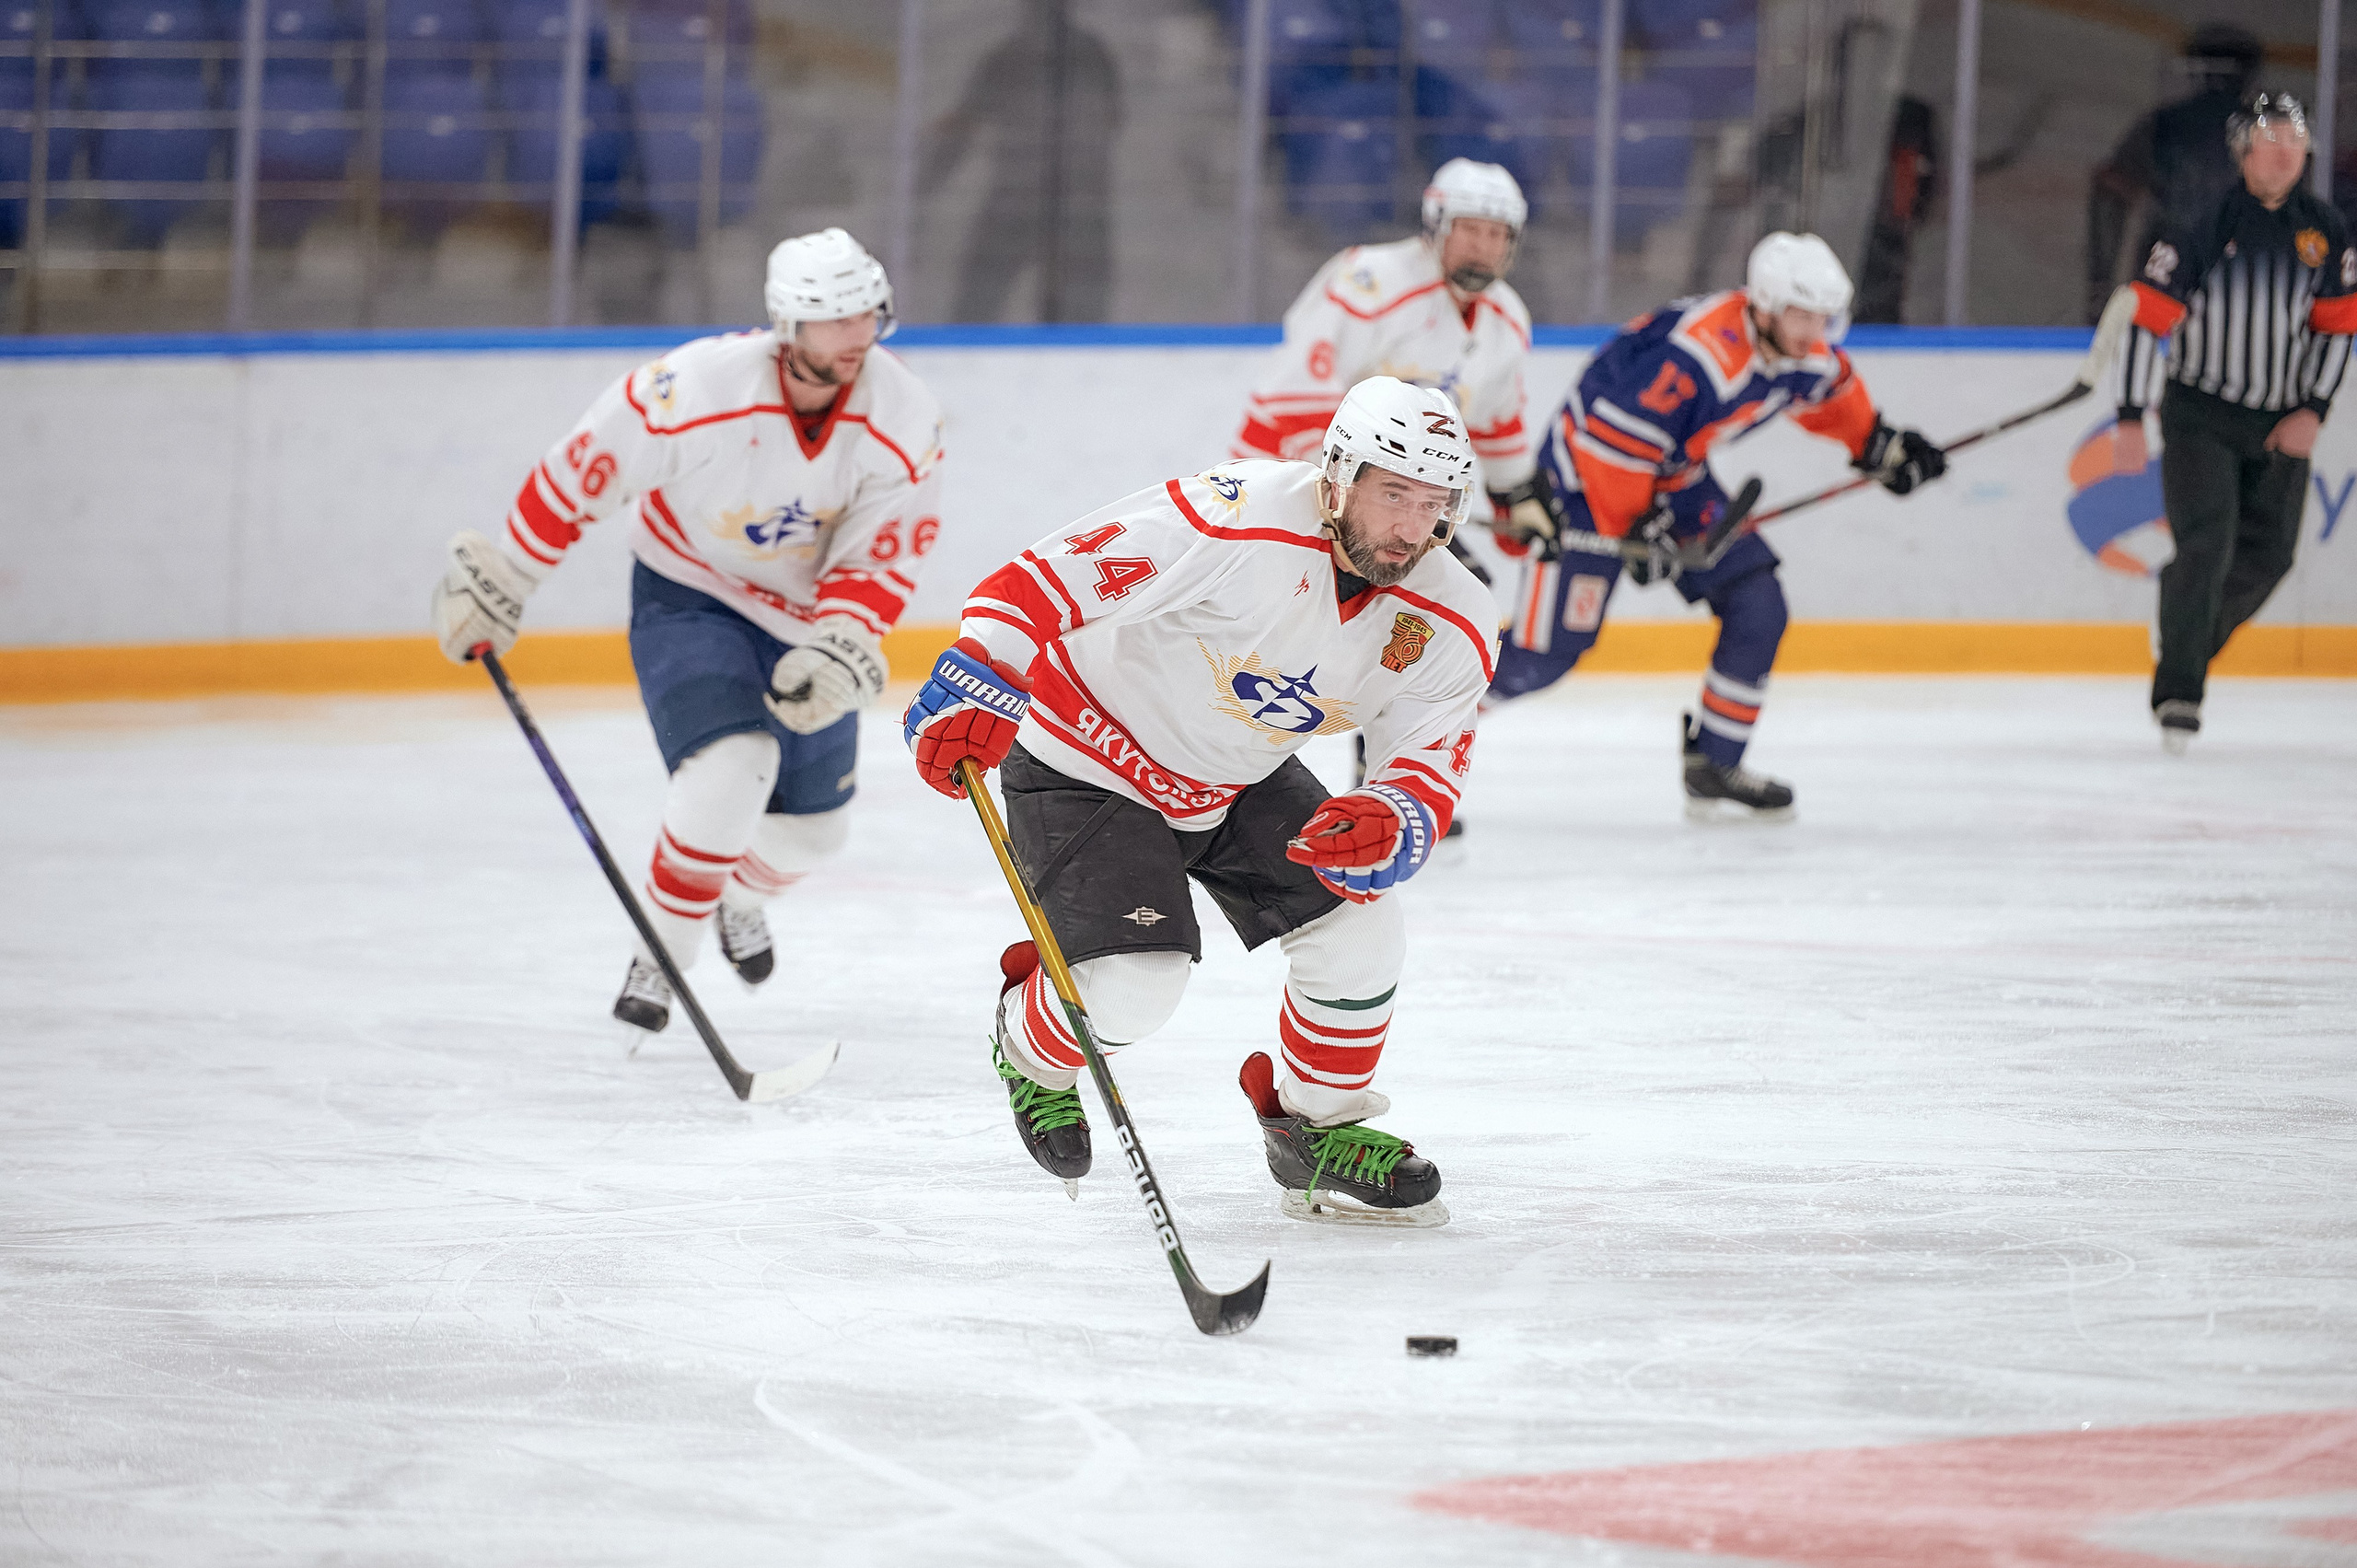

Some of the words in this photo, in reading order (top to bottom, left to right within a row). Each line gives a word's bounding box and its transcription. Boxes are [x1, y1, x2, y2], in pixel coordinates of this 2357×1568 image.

[1335, 424, 1353, 441] CCM
[1422, 447, 1460, 462] CCM
[455, 546, 523, 620] EASTO
[1063, 521, 1158, 602] 44
[1401, 617, 1427, 634] 1941-1945
[938, 658, 1029, 718] WARRIO
[1365, 784, 1426, 865] ARRIOR
